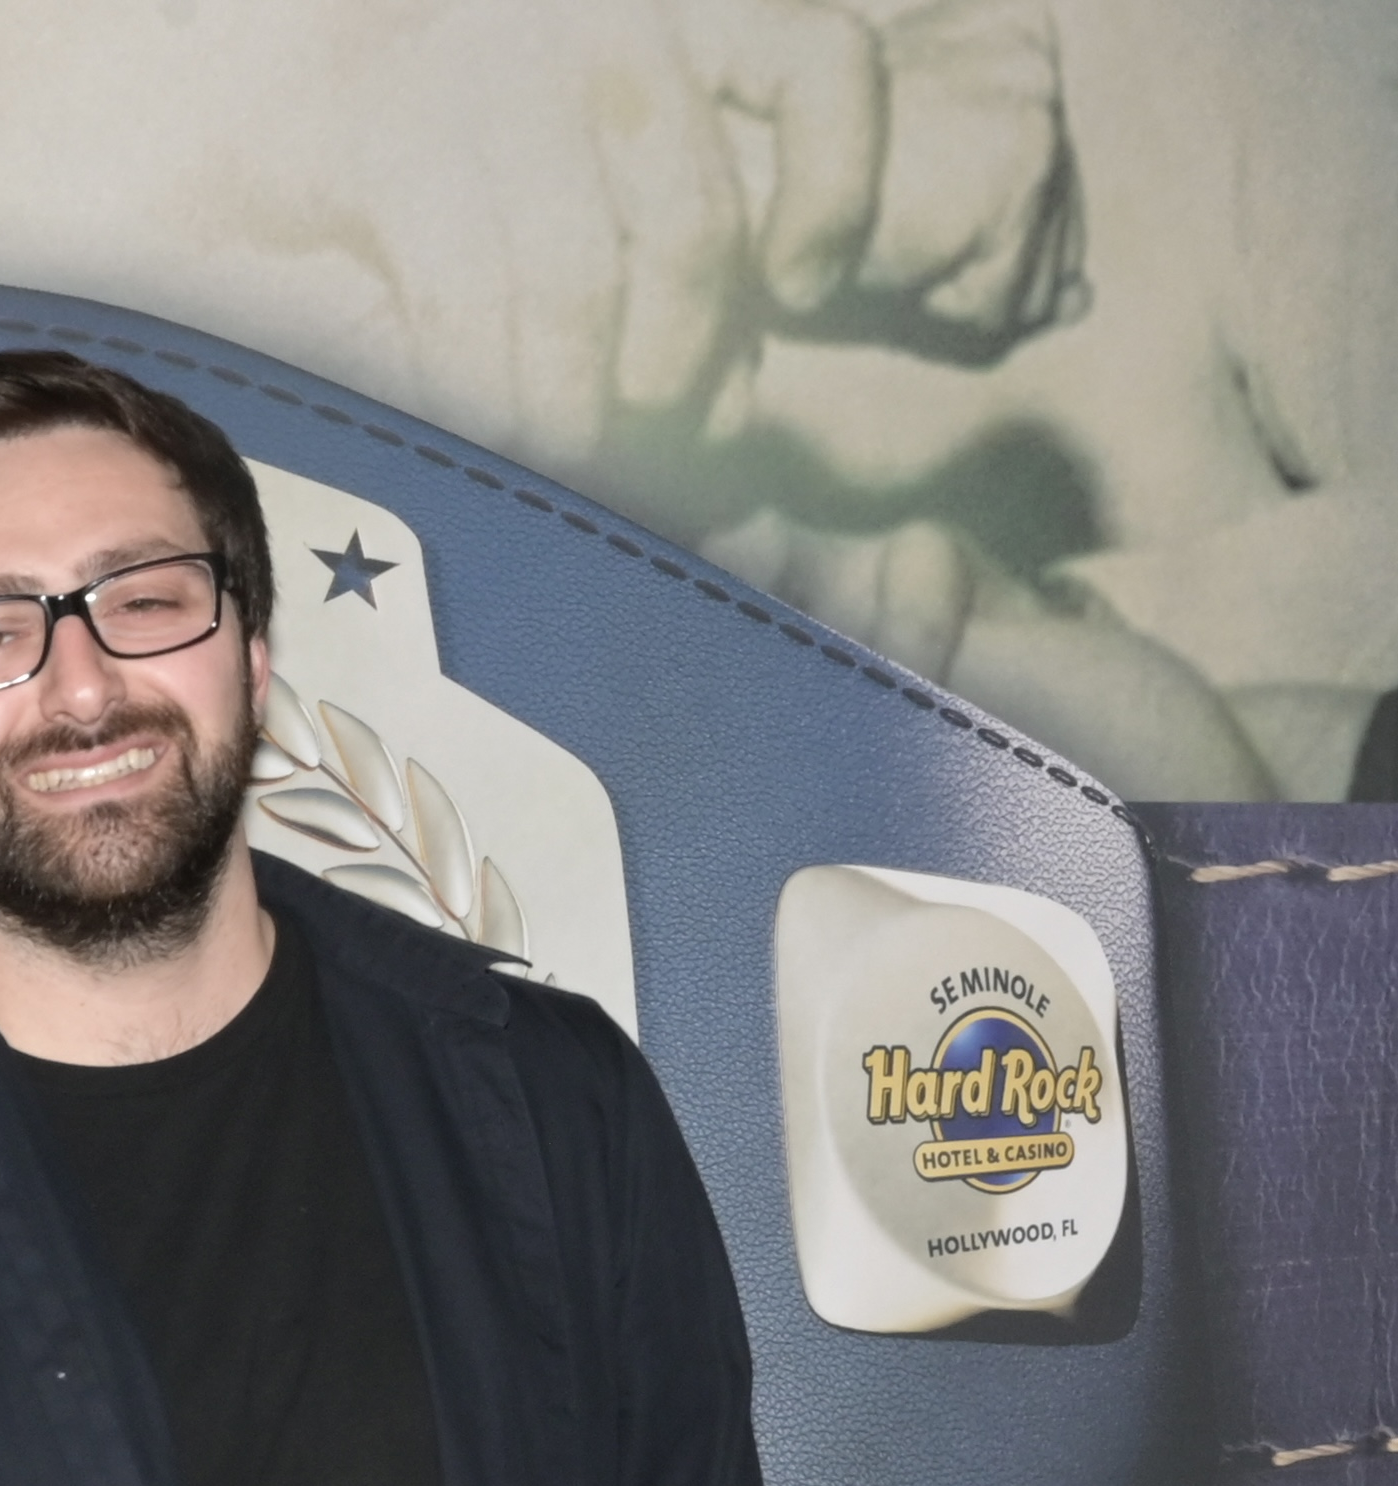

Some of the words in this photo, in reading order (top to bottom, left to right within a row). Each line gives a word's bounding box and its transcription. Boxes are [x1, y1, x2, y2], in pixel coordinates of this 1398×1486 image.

[930, 967, 1050, 1018] SEMINOLE
[863, 1046, 996, 1124] Hard
[1001, 1046, 1102, 1127] Rock
[922, 1148, 982, 1170] HOTEL
[986, 1147, 1000, 1163] &
[1004, 1141, 1068, 1162] CASINO
[927, 1222, 1057, 1257] HOLLYWOOD,
[1062, 1219, 1078, 1237] FL
